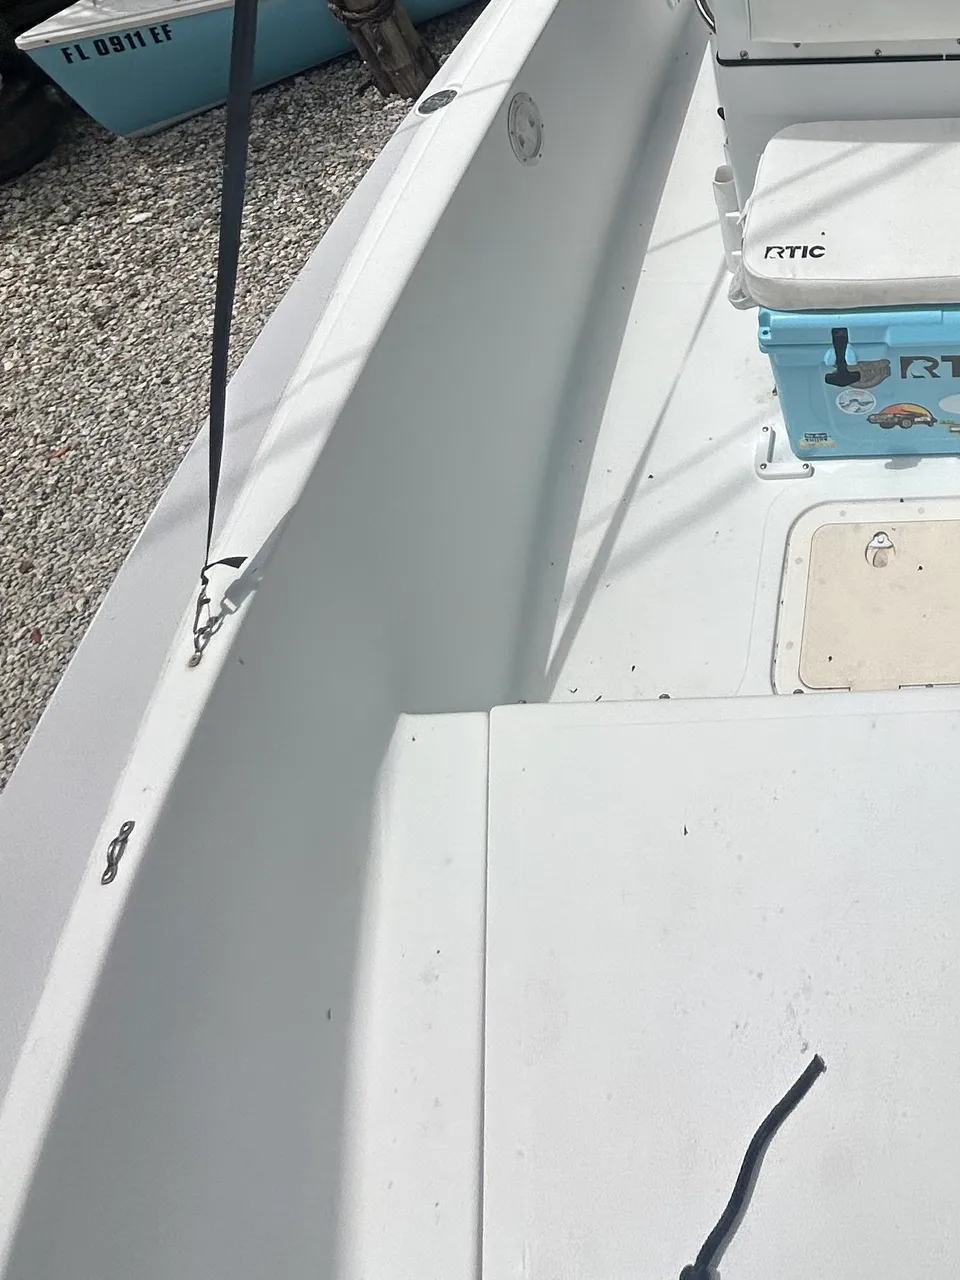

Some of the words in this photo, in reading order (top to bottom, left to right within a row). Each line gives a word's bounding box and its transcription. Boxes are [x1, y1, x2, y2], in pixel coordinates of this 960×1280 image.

[61, 44, 91, 64] FL
[93, 30, 147, 56] 0911
[149, 24, 173, 44] EF
[764, 245, 826, 259] RTIC
